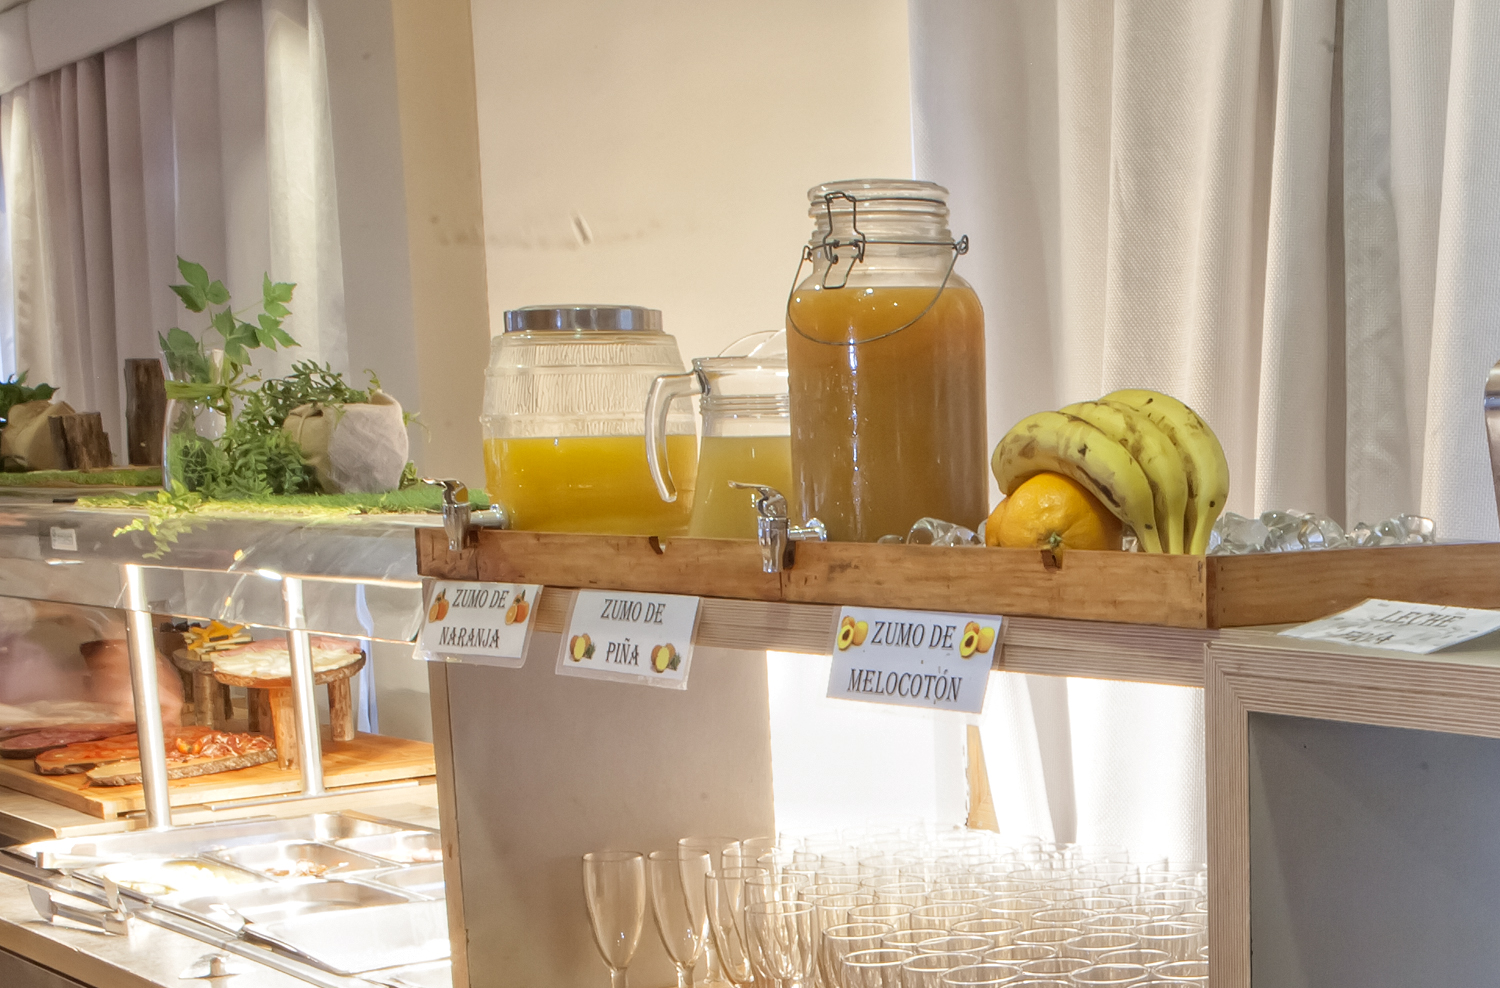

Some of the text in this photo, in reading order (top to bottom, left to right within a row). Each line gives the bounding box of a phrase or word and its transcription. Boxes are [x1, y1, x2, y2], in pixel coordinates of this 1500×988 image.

[452, 589, 510, 609] ZUMO DE
[600, 598, 667, 625] ZUMO DE
[438, 626, 500, 649] NARANJA
[870, 620, 957, 651] ZUMO DE
[605, 637, 639, 667] PIÑA
[847, 668, 963, 702] MELOCOTÓN
